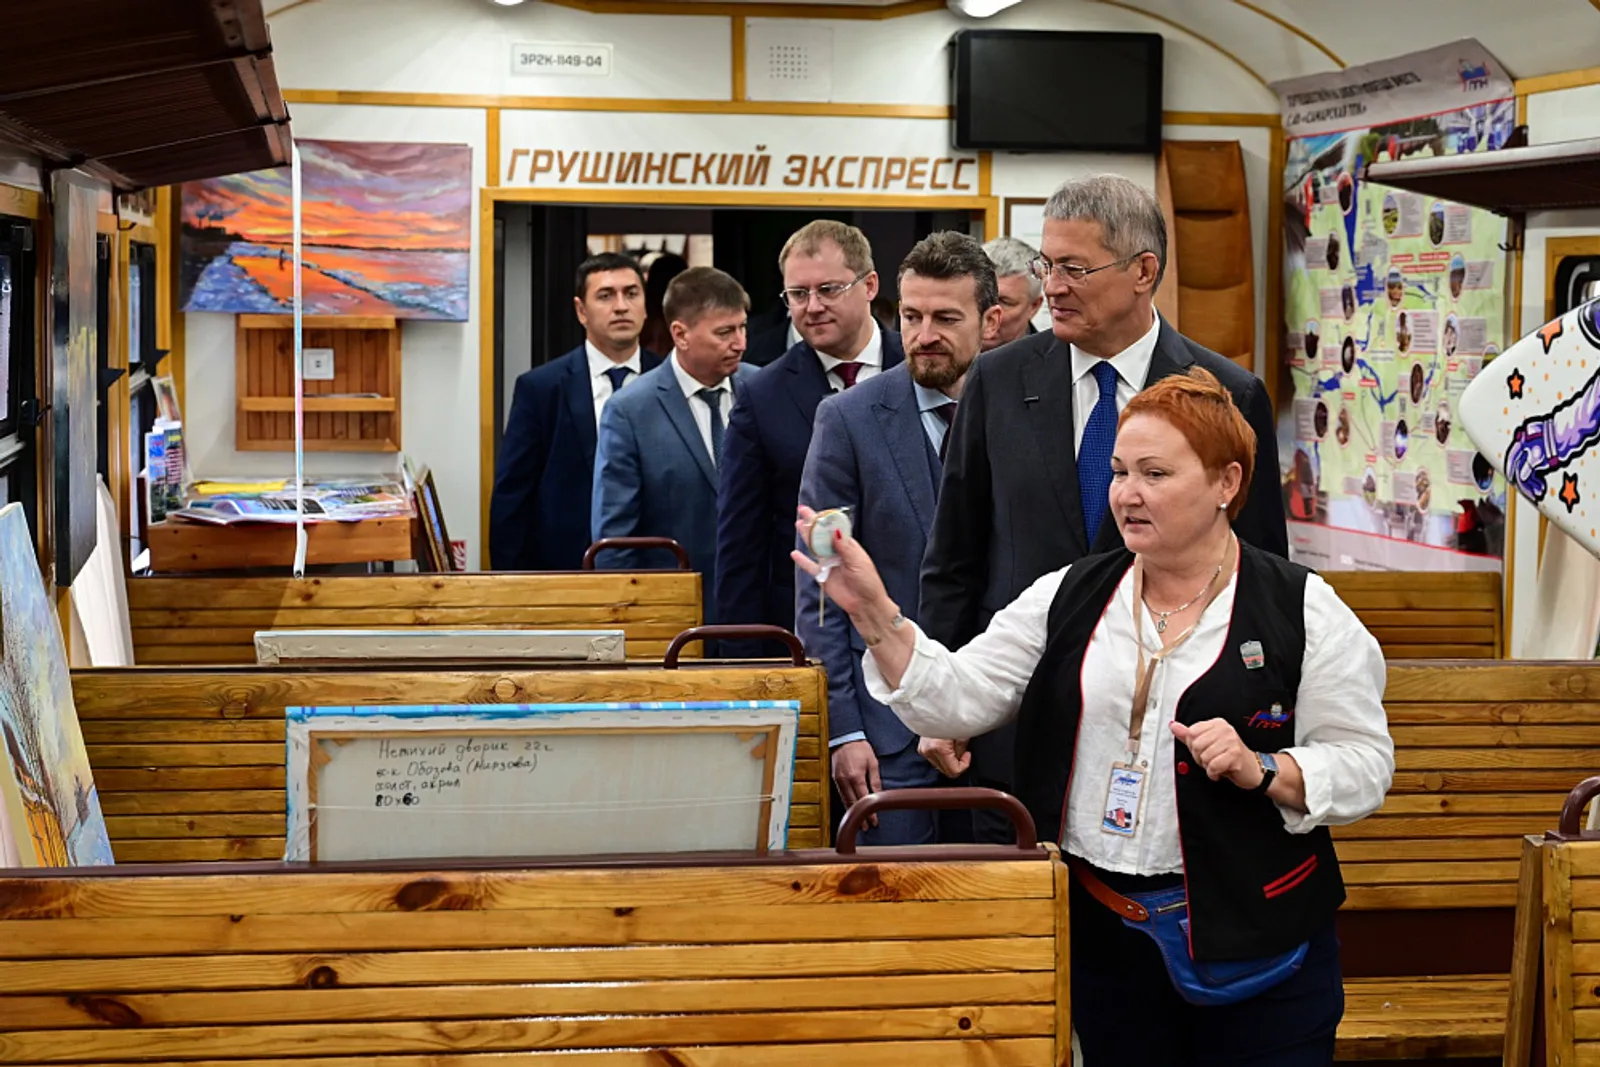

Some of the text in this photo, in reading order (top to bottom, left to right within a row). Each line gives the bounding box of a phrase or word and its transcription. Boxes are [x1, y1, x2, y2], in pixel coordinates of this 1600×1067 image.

[506, 144, 977, 191] ГРУШИНСКИЙ ЭКСПРЕСС
[455, 738, 509, 762] дворик
[421, 778, 462, 794] акрил
